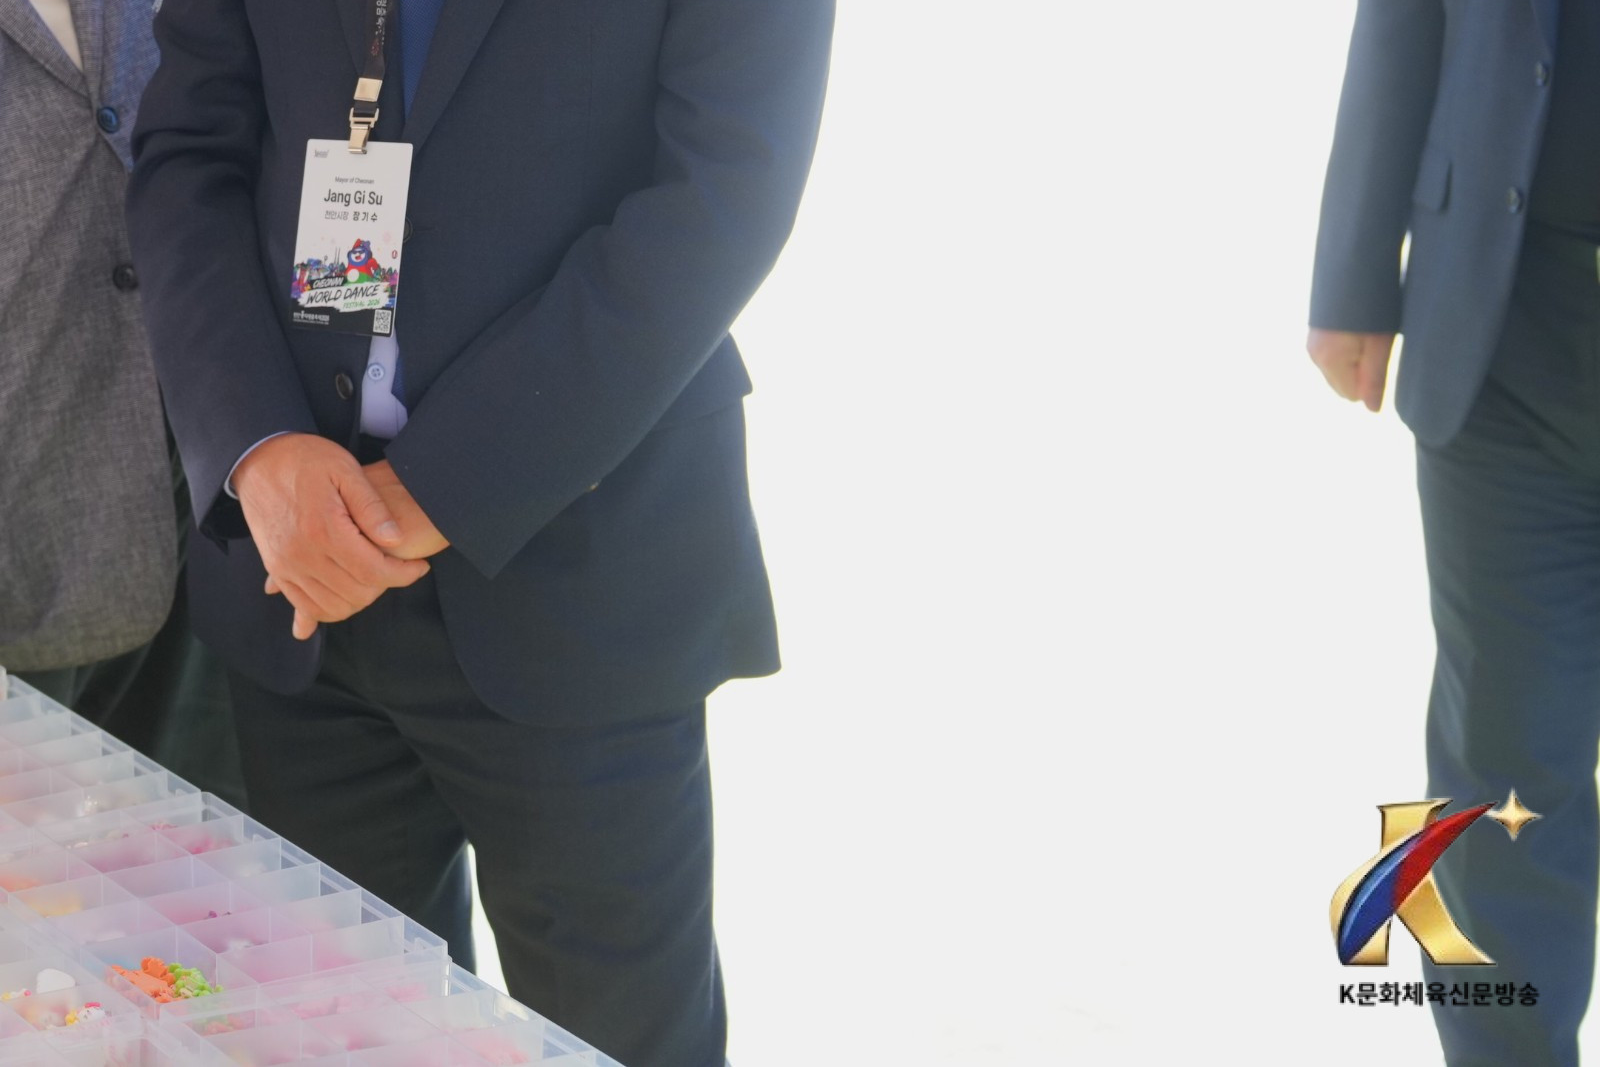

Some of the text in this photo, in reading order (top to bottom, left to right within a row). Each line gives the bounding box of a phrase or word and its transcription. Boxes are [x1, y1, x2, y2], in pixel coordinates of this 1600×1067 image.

[334, 176, 349, 185] Mayor
[324, 188, 383, 207] Jang Gi Su
[324, 210, 350, 221] 천안시장
[306, 284, 381, 305] WORLD DANCE
